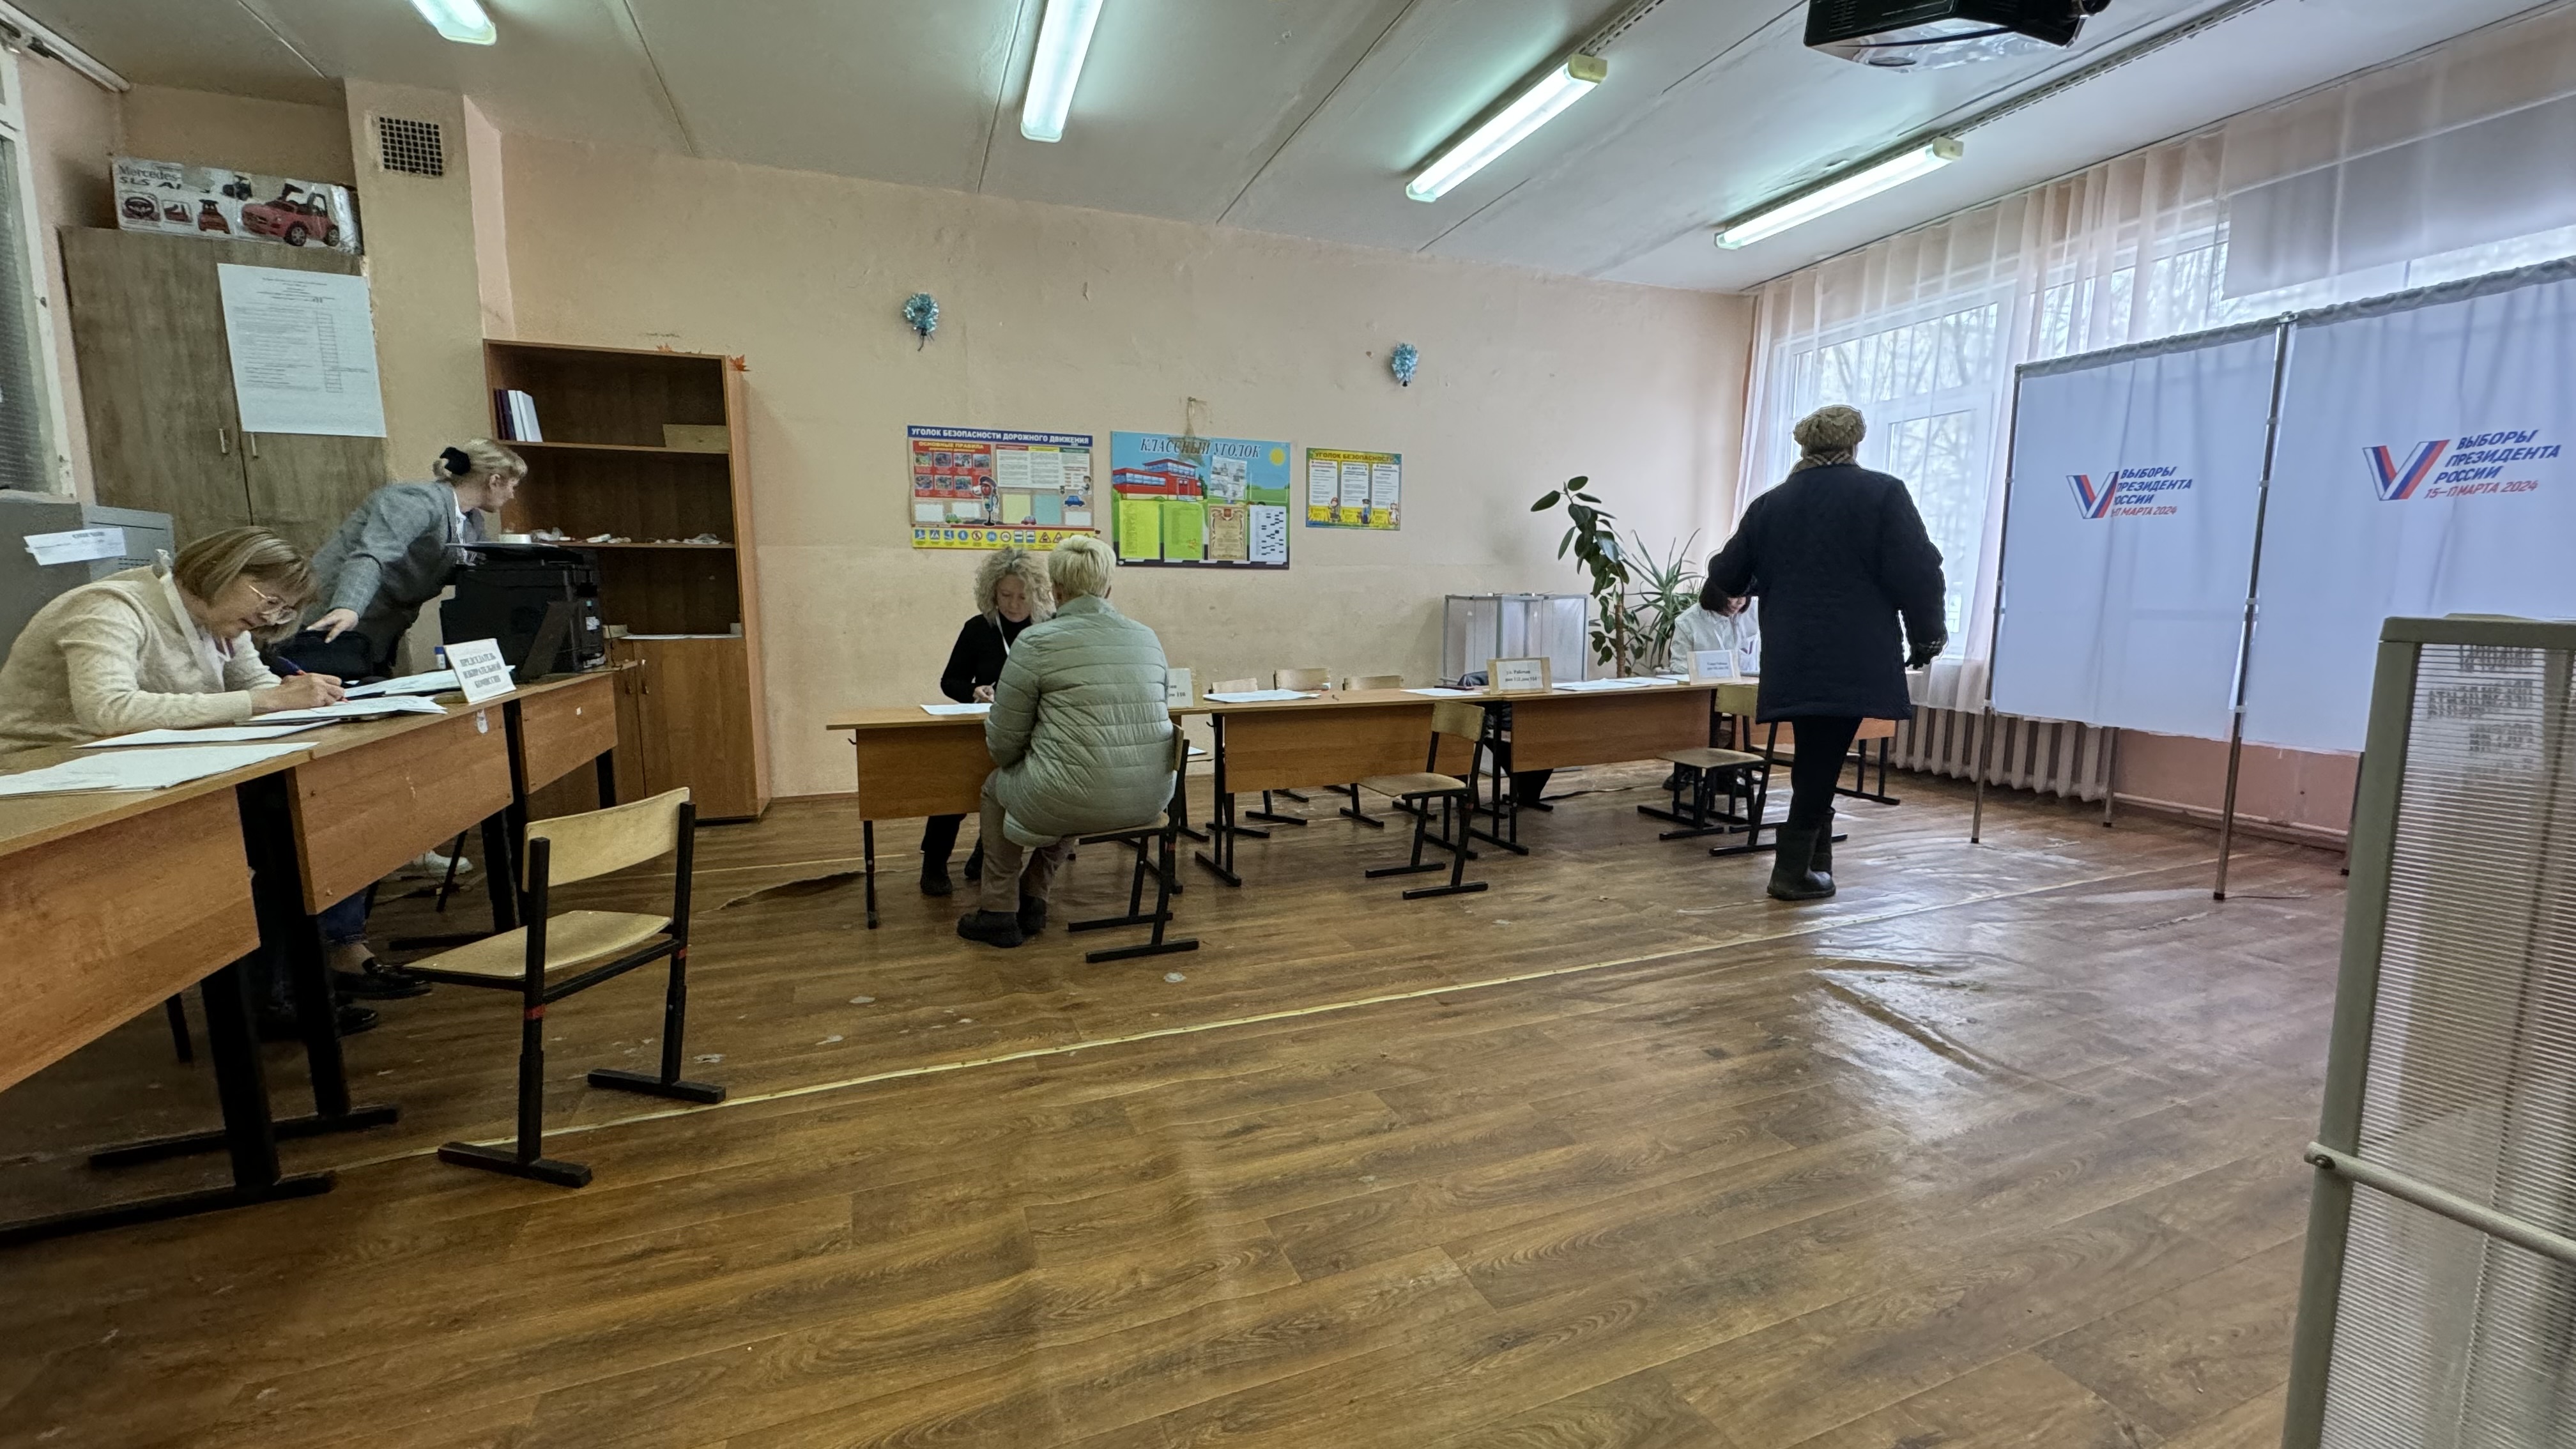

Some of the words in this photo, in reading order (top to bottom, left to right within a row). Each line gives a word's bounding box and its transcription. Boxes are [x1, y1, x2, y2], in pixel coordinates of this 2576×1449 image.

[943, 430, 1002, 440] БЕЗОПАСНОСТИ
[1003, 433, 1048, 442] ДОРОЖНОГО
[2456, 429, 2540, 450] ВЫБОРЫ
[1140, 438, 1211, 455] КЛАССНЫЙ
[1213, 443, 1261, 458] УГОЛОК
[2444, 445, 2561, 467] ПРЕЗИДЕНТА
[2120, 466, 2177, 479] ВЫБОРЫ
[2433, 465, 2504, 484] РОССИИ
[2116, 479, 2193, 492] ПРЕЗИДЕНТА
[2457, 482, 2499, 496] МАРТА
[2500, 480, 2539, 493] 2024
[2114, 494, 2155, 505] ОССИИ
[2120, 507, 2153, 516] МАРТА
[2152, 506, 2177, 515] 2024
